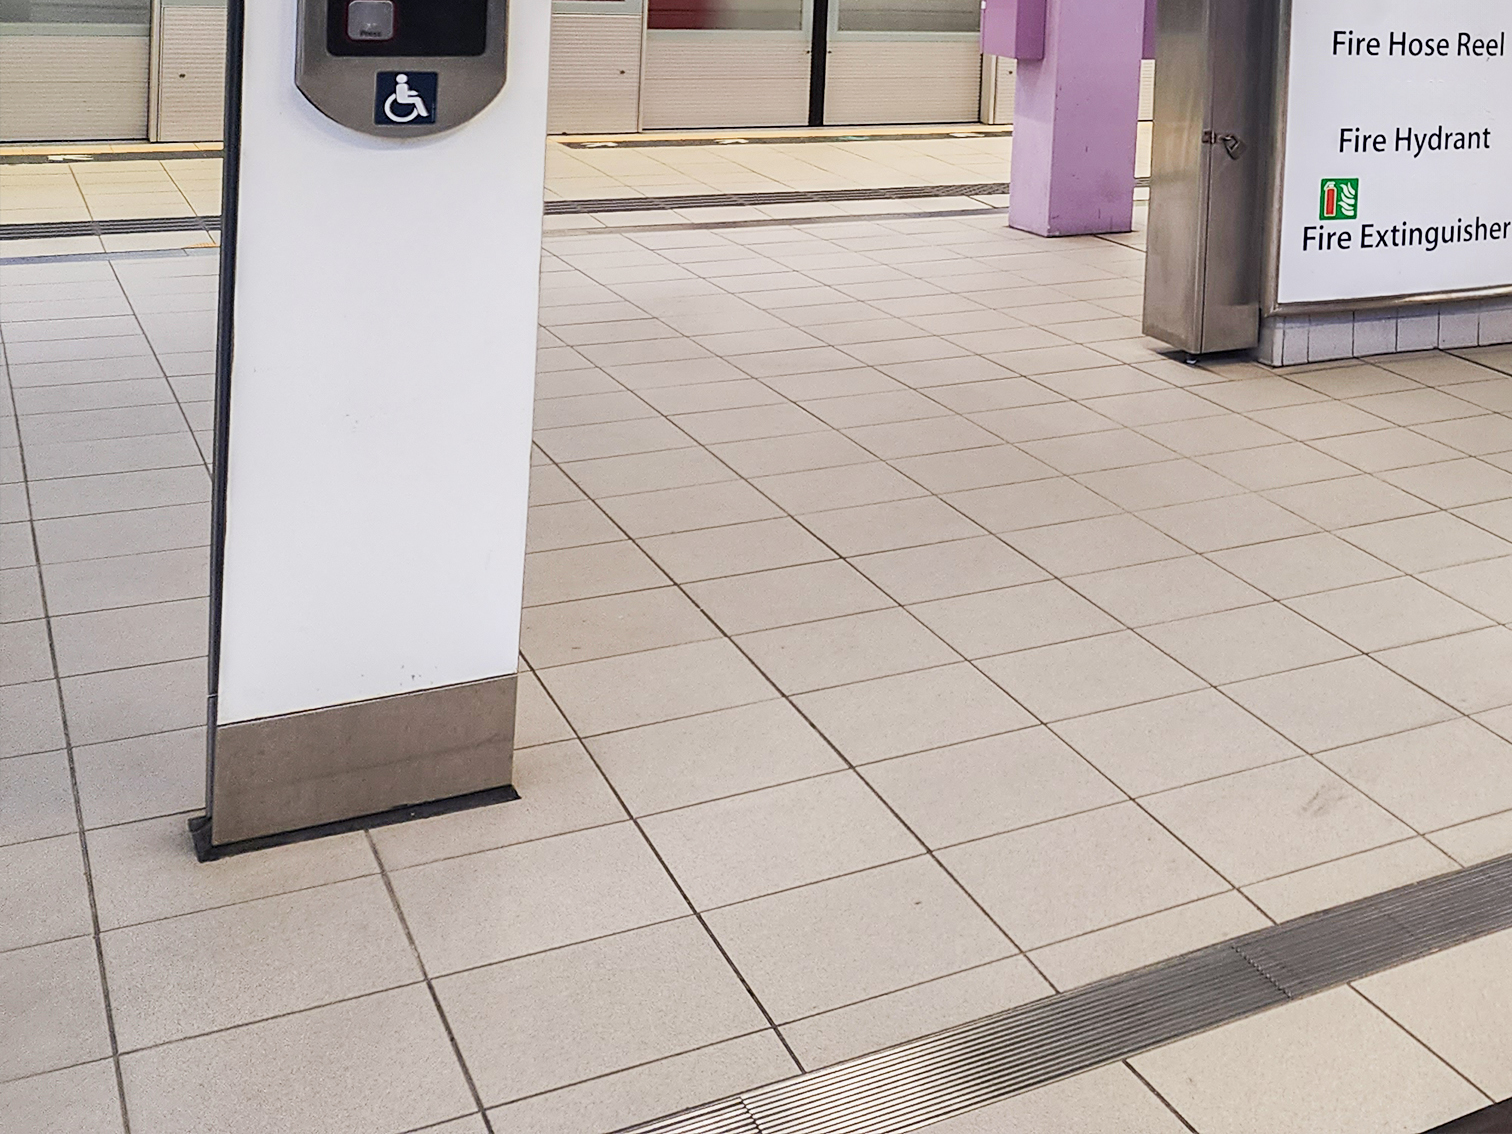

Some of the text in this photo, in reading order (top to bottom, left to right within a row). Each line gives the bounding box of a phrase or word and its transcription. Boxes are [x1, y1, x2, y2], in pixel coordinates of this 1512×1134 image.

[1332, 30, 1505, 56] Fire Hose Reel
[1339, 125, 1491, 159] Fire Hydrant
[1302, 216, 1511, 252] Fire Extinguisher
